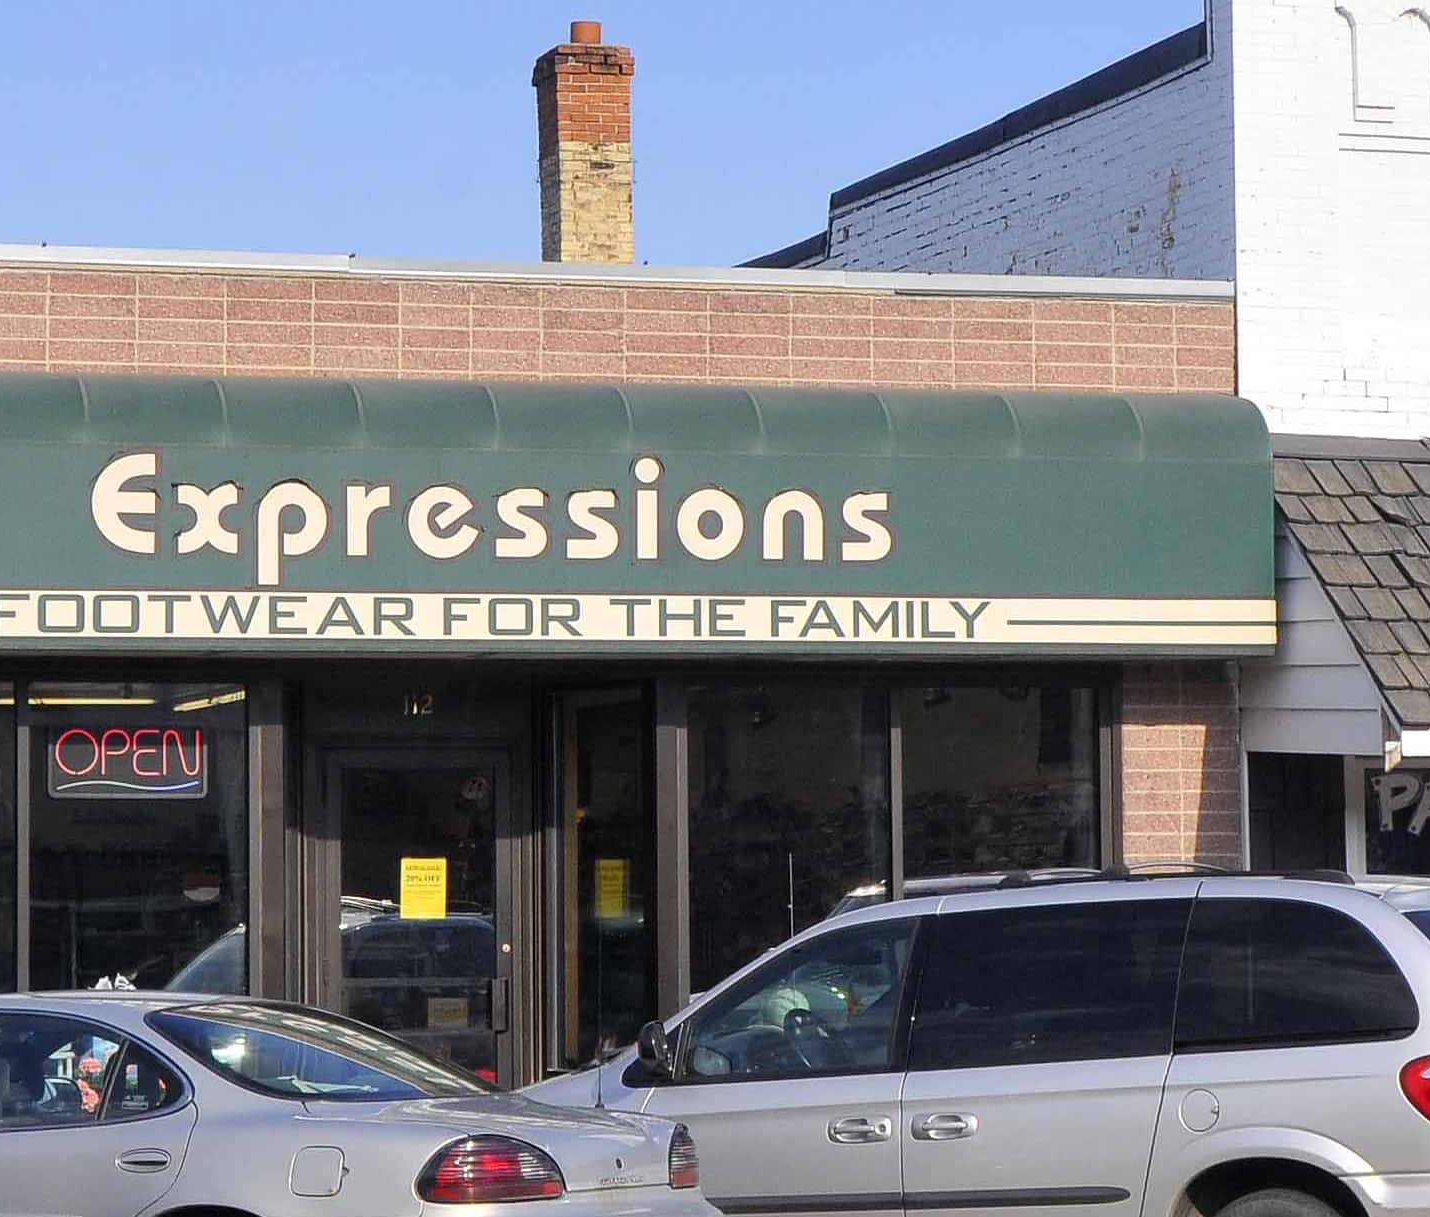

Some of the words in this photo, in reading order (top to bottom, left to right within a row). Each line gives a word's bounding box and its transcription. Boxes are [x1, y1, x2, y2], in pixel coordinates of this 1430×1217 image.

[90, 452, 894, 586] Expressions
[442, 597, 583, 636] FOR
[609, 598, 746, 637] THE
[771, 600, 991, 639] FAMILY
[55, 728, 201, 776] OPEN
